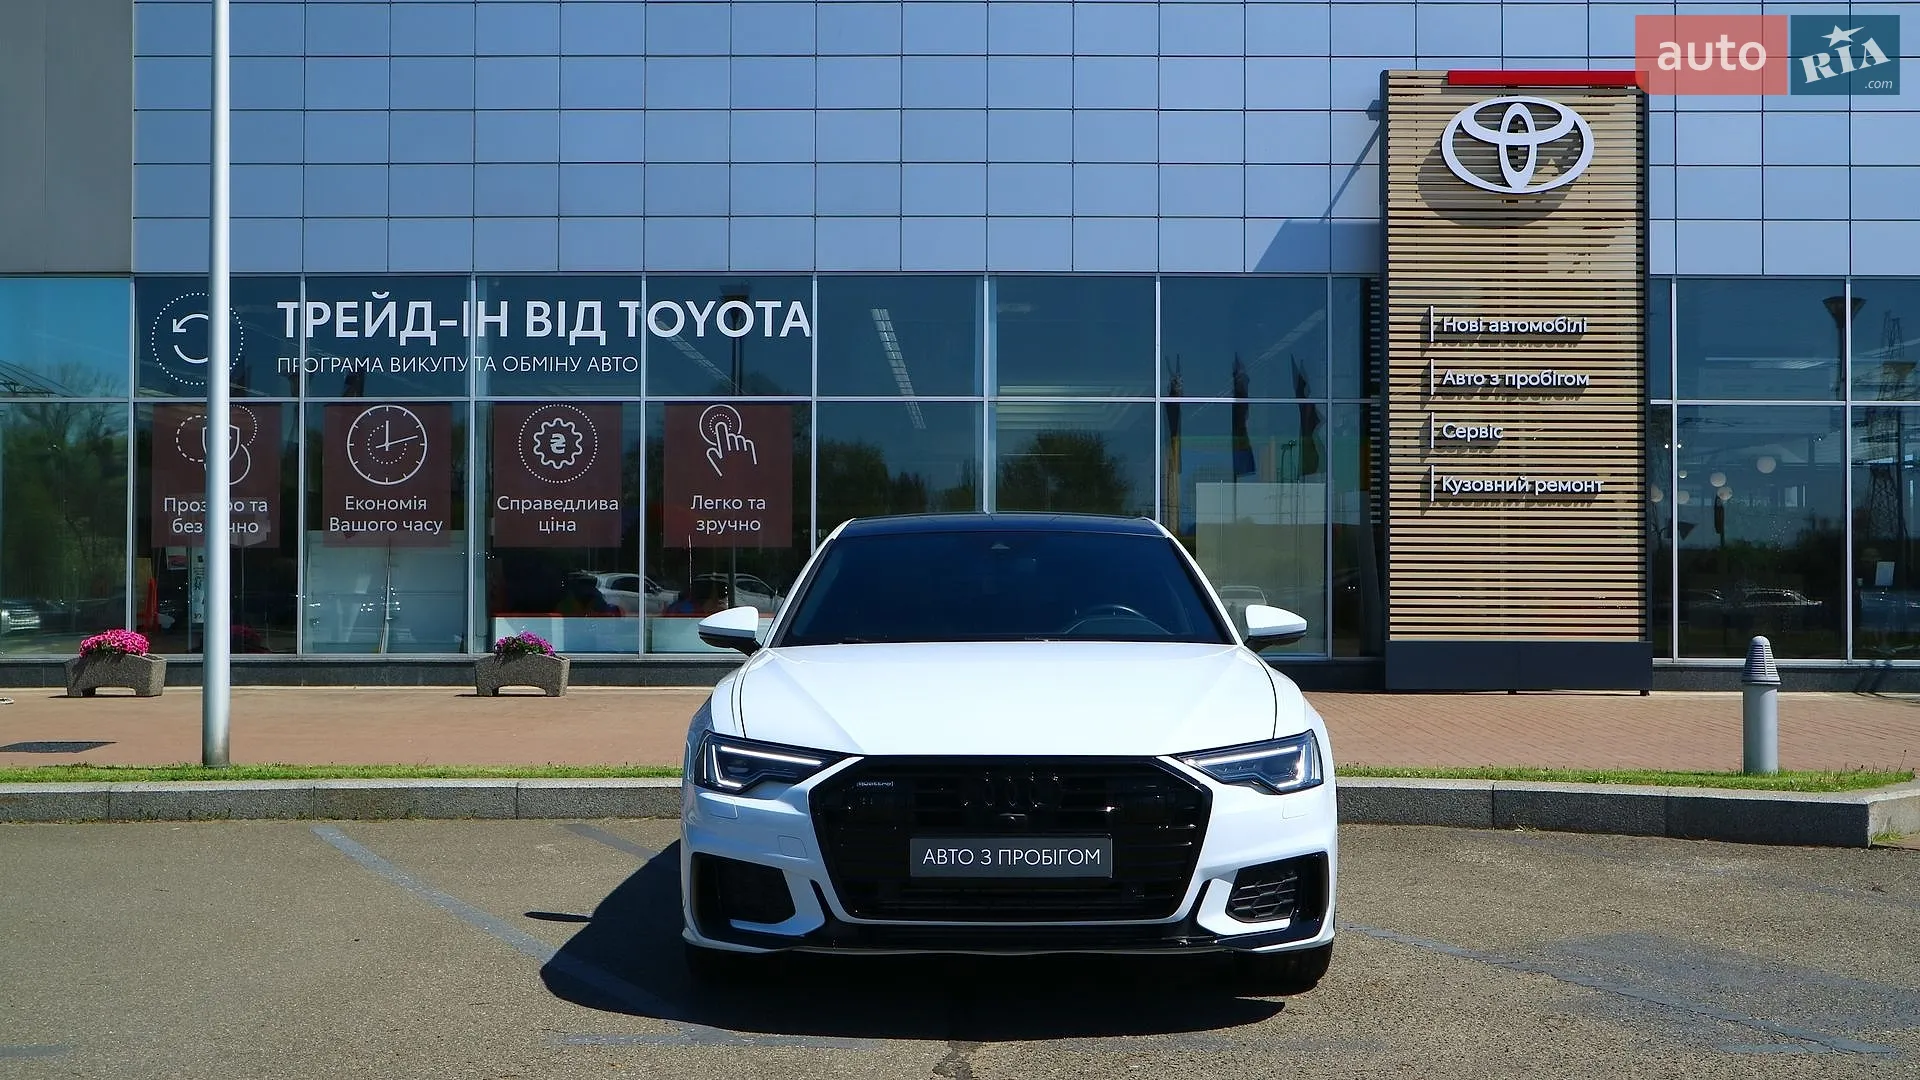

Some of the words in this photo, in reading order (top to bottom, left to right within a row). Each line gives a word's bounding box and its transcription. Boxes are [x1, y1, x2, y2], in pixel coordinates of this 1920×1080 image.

[277, 291, 508, 346] ТРЕЙД-ІН
[526, 301, 606, 346] ВІД
[619, 301, 812, 338] TOYOTA
[1442, 317, 1483, 333] Нові
[1488, 316, 1588, 333] автомобілі
[277, 357, 384, 373] ПРОГРАМА
[390, 357, 469, 373] ВИКУПУ
[474, 357, 497, 372] ТА
[502, 356, 582, 372] ОБМІНУ
[587, 356, 639, 372] АВТО
[1442, 370, 1485, 385] Авто
[1491, 375, 1500, 385] з
[1505, 370, 1590, 389] пробігом
[1442, 423, 1504, 442] Сервіс
[1442, 475, 1530, 495] Кузовний
[1535, 479, 1604, 495] ремонт
[164, 497, 245, 516] Прозо
[249, 501, 268, 512] та
[345, 495, 427, 510] Економія
[497, 496, 619, 514] Справедлива
[691, 496, 743, 510] Легко
[747, 499, 766, 510] та
[172, 518, 259, 533] безчно
[329, 518, 398, 532] Вашого
[402, 520, 443, 535] часу
[539, 517, 576, 536] ціна
[696, 521, 761, 536] зручно
[923, 849, 974, 865] АВТО
[998, 848, 1101, 866] ПРОБІГОМ
